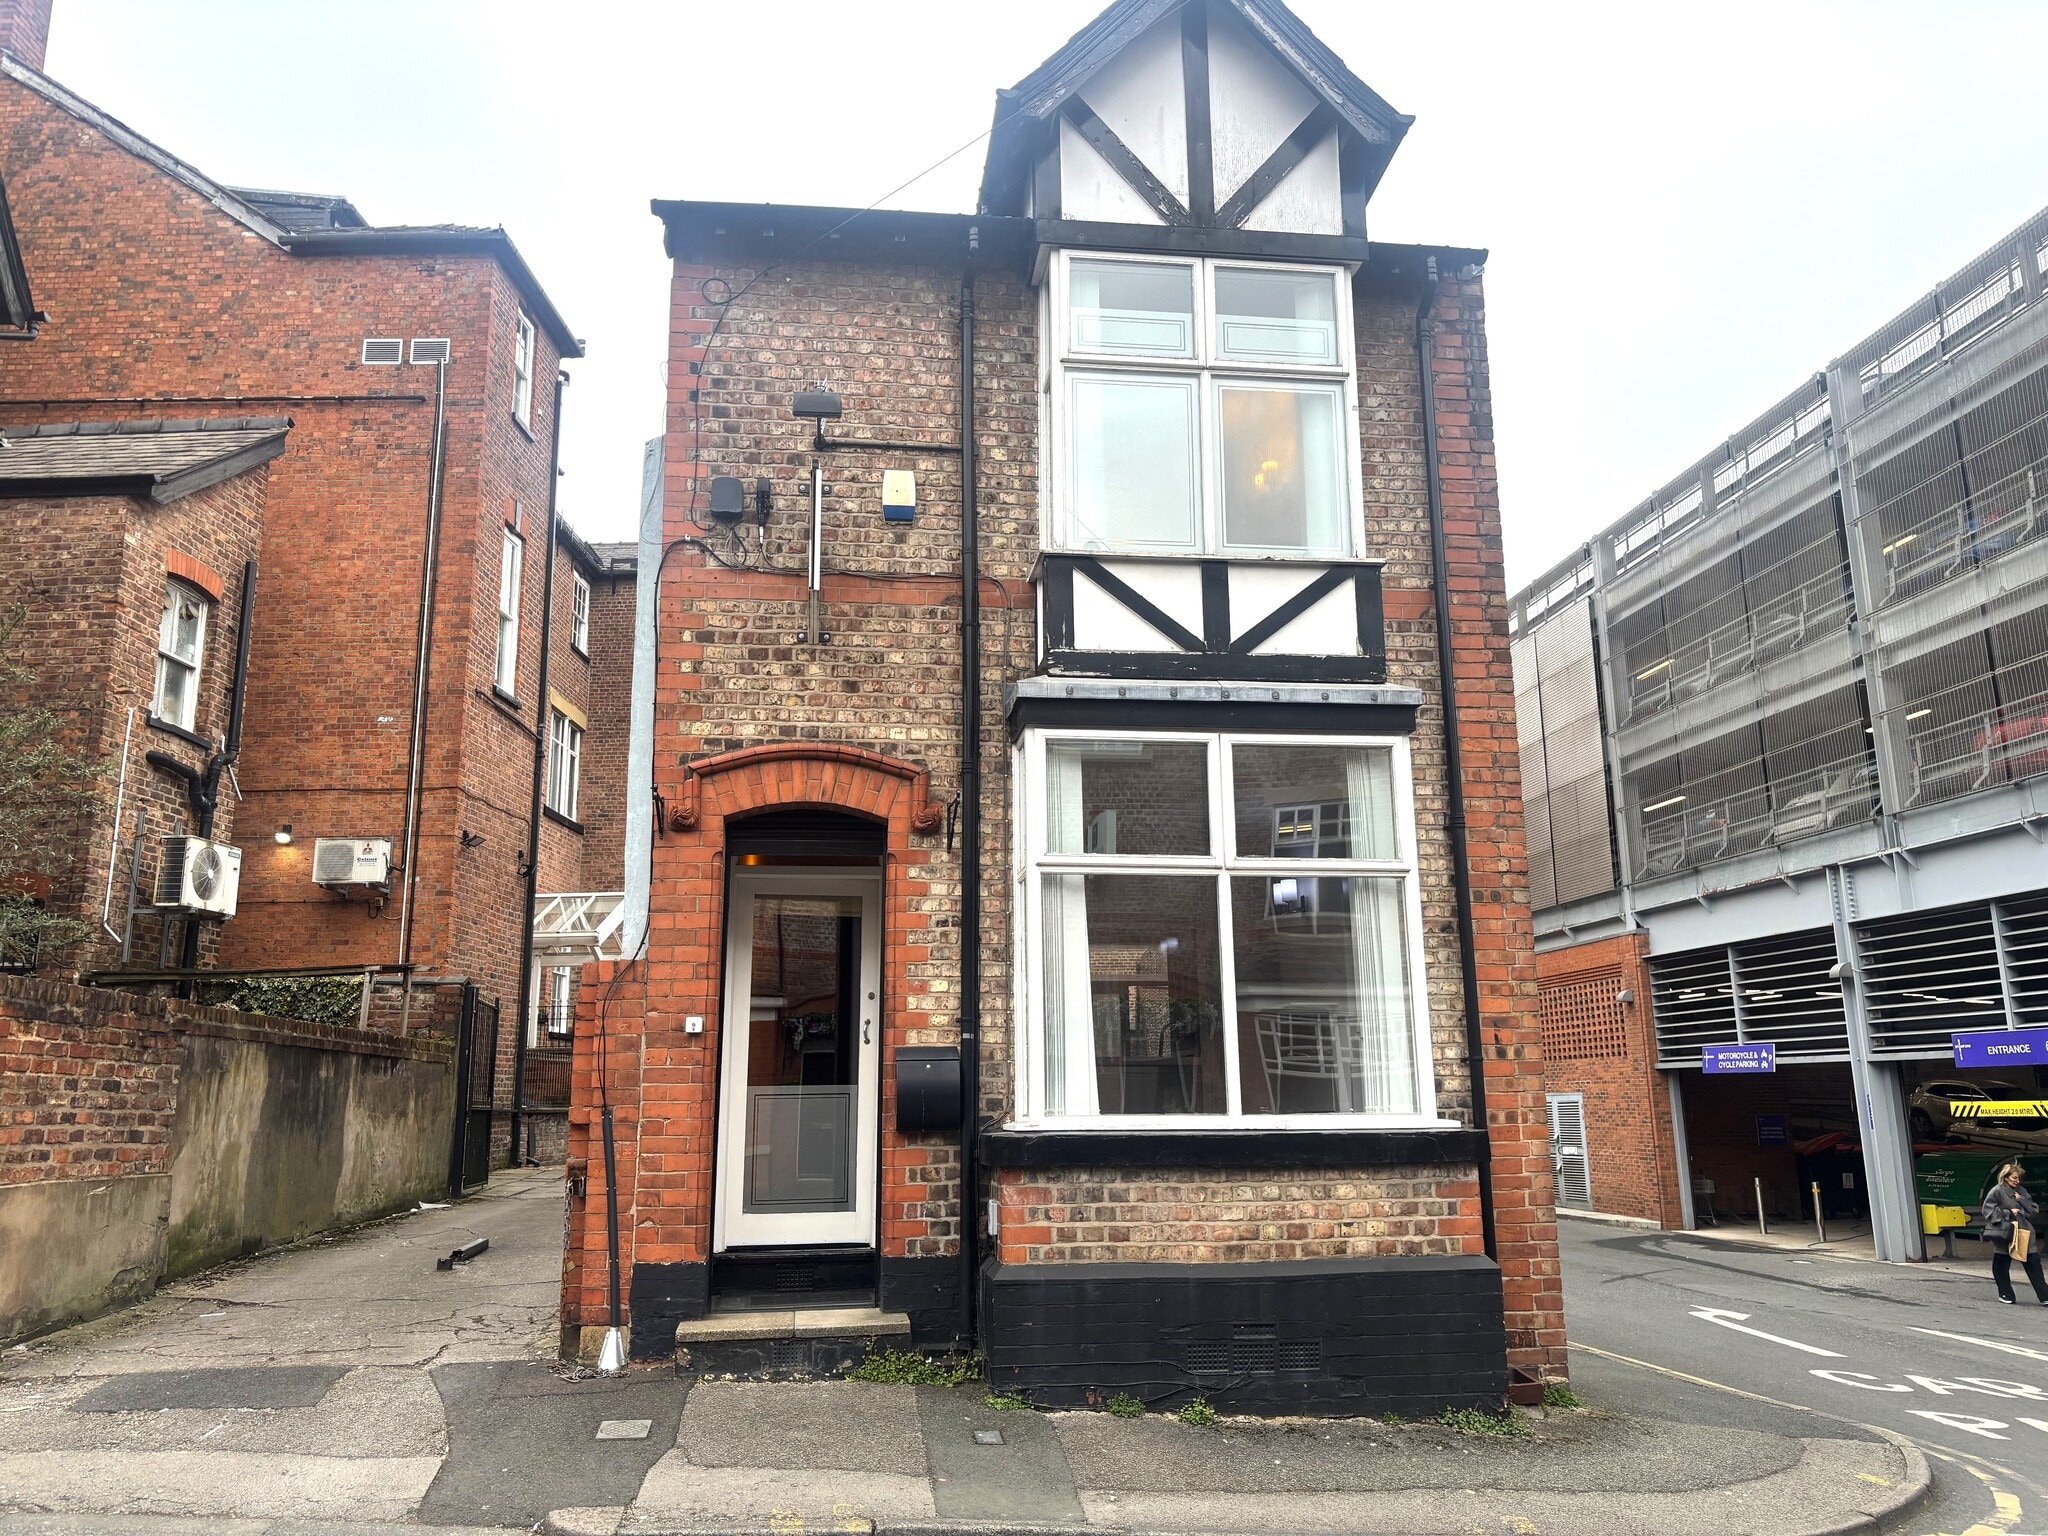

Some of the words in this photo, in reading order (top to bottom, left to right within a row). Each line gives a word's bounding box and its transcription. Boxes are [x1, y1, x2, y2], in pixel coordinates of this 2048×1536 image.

[1987, 1044, 2031, 1055] ENTRANCE
[1718, 1052, 1753, 1060] MOTORCYCLE
[1753, 1051, 1758, 1059] &
[1736, 1060, 1758, 1068] PARKING
[1808, 1369, 2048, 1401] CAR
